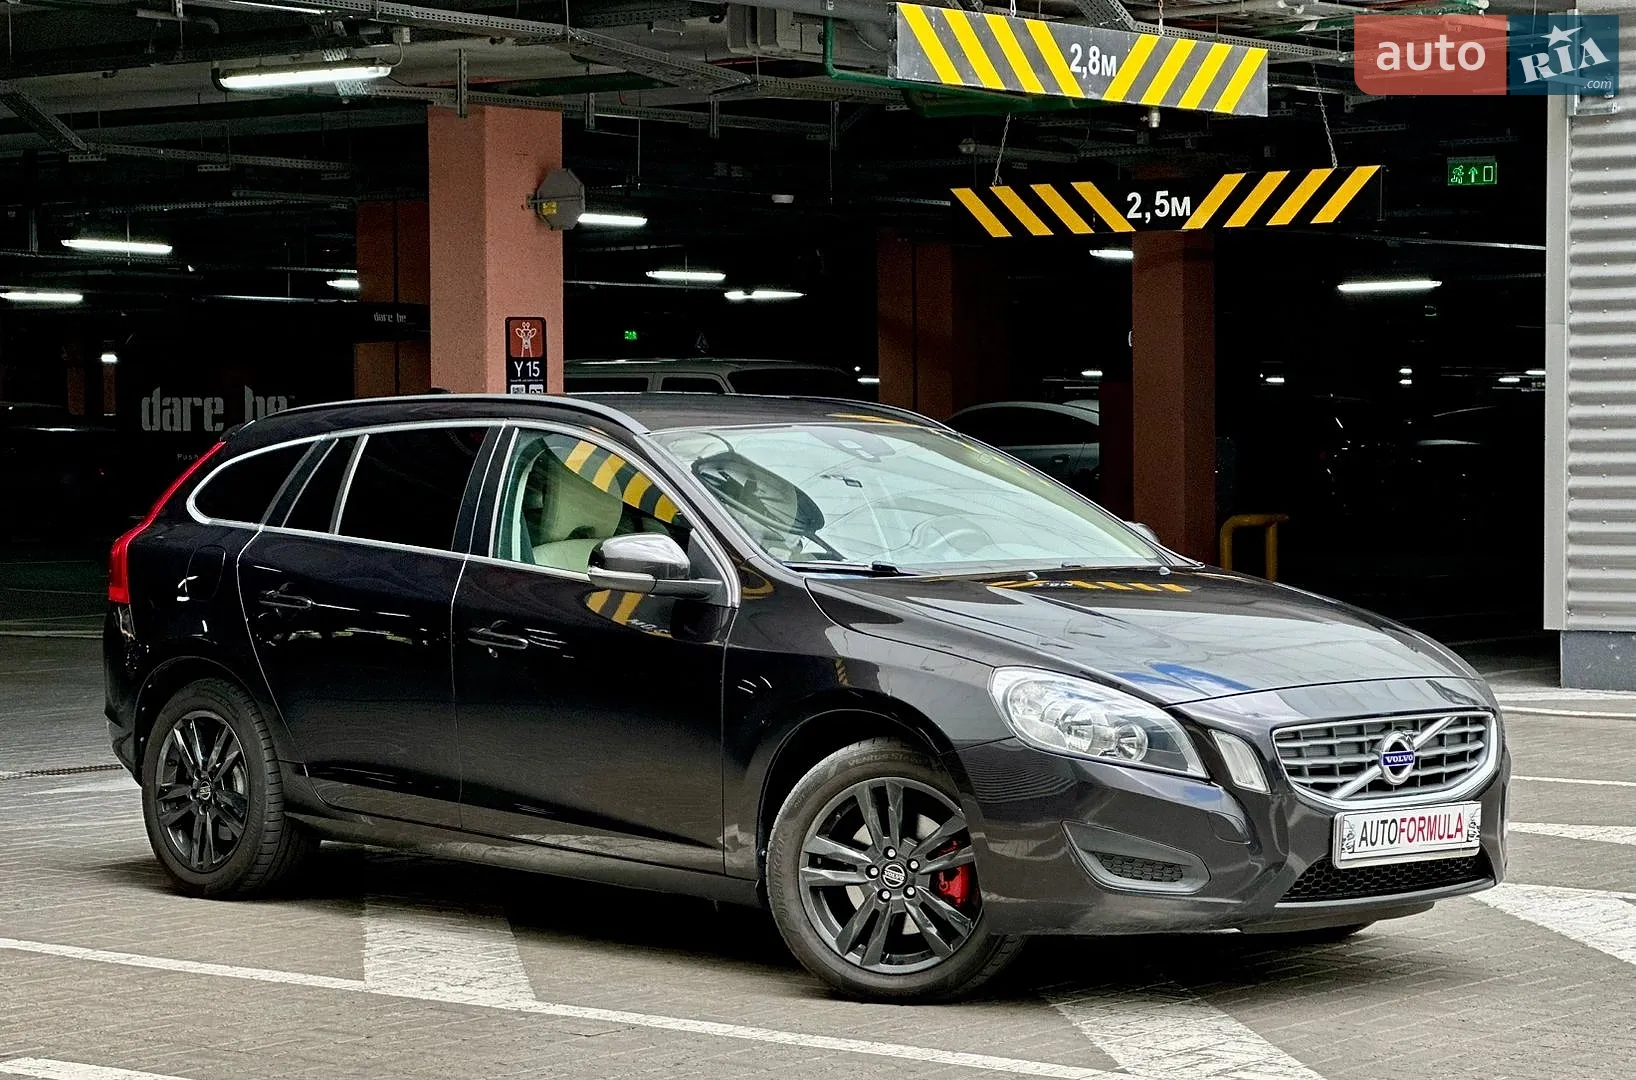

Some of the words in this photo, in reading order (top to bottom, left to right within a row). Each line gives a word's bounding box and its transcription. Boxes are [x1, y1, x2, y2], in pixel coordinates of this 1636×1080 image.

[514, 361, 523, 377] Y
[526, 361, 540, 377] 15
[141, 386, 224, 431] dare
[1385, 754, 1414, 763] VOLVO
[1358, 812, 1464, 848] AUTOFORMULA
